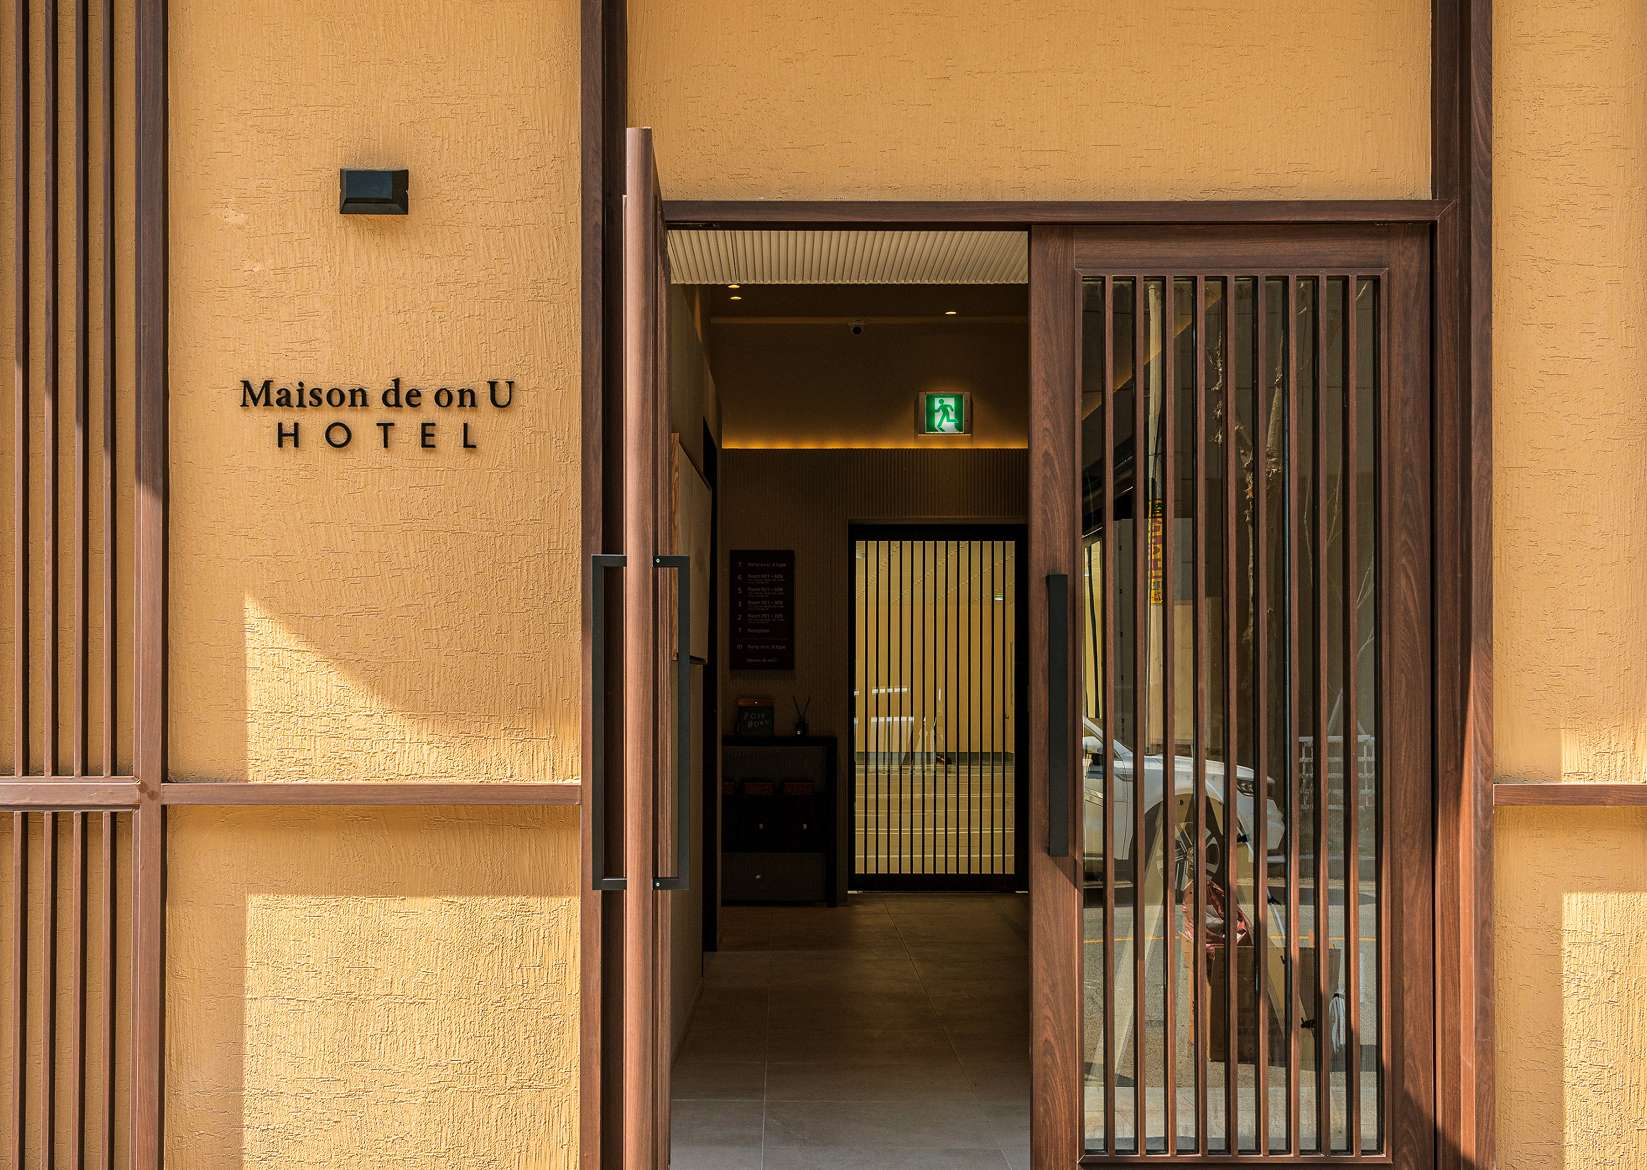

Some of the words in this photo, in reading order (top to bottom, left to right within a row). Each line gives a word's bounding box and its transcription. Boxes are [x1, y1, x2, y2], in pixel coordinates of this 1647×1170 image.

[240, 379, 369, 408] Maison
[381, 377, 422, 408] de
[434, 384, 478, 408] on
[487, 380, 515, 408] U
[277, 422, 477, 449] HOTEL
